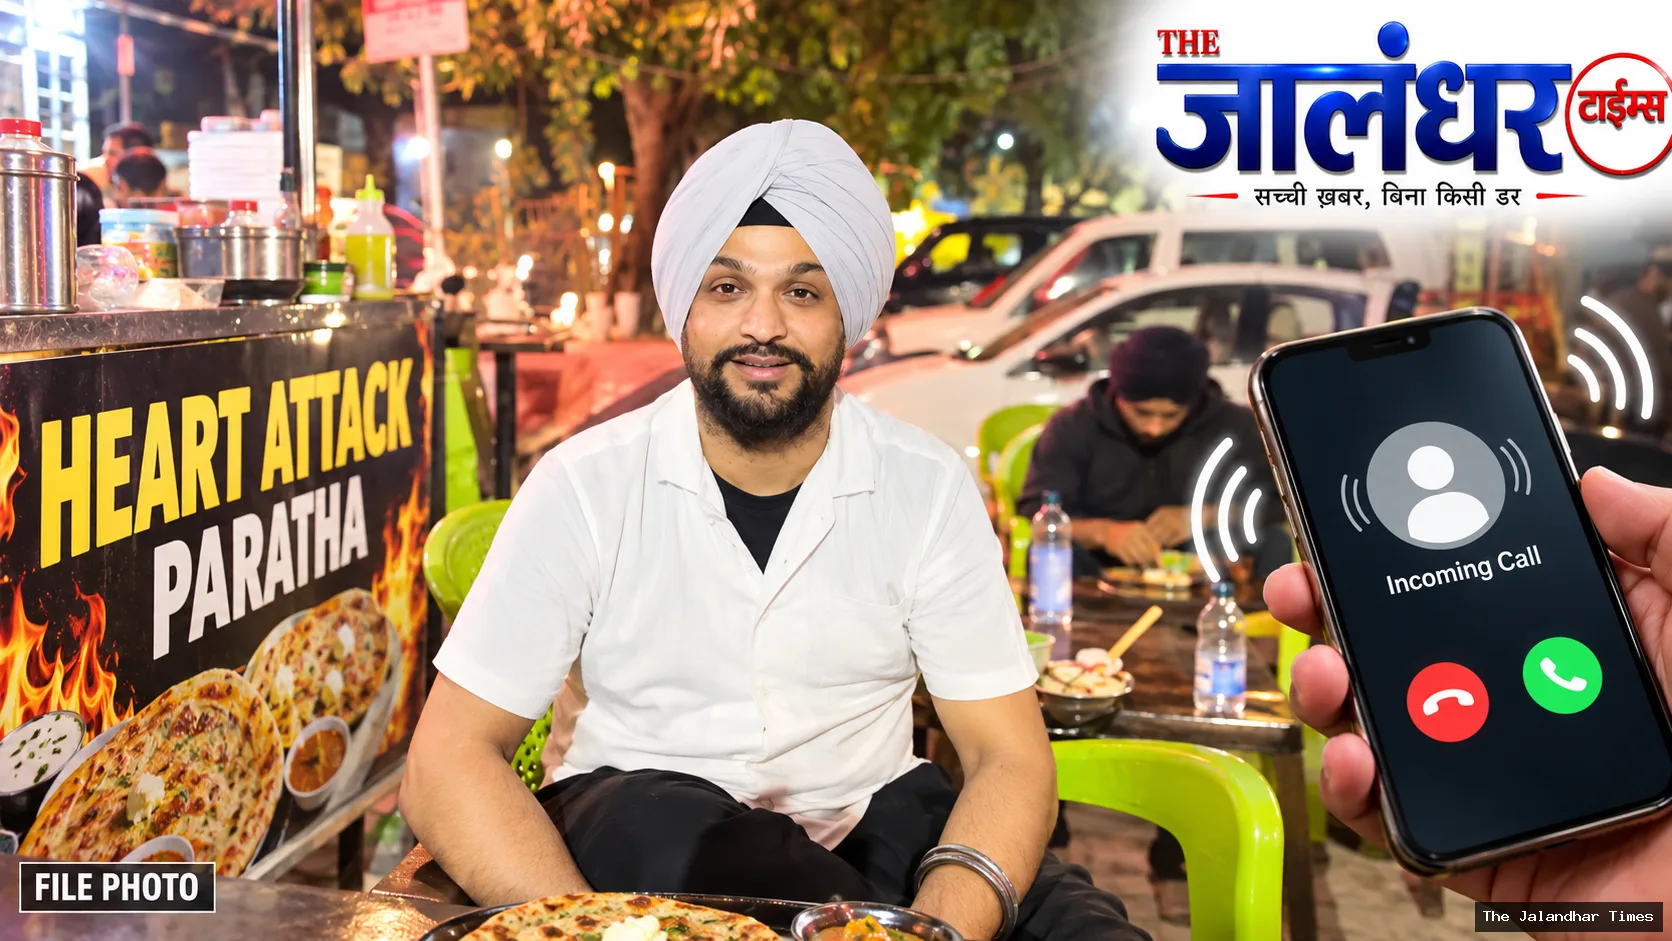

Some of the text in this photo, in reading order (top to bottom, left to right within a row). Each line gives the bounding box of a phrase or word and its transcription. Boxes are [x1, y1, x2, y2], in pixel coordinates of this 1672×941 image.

[39, 357, 414, 569] HEART ATTACK
[152, 475, 369, 660] PARATHA
[1386, 545, 1542, 595] Incoming Call
